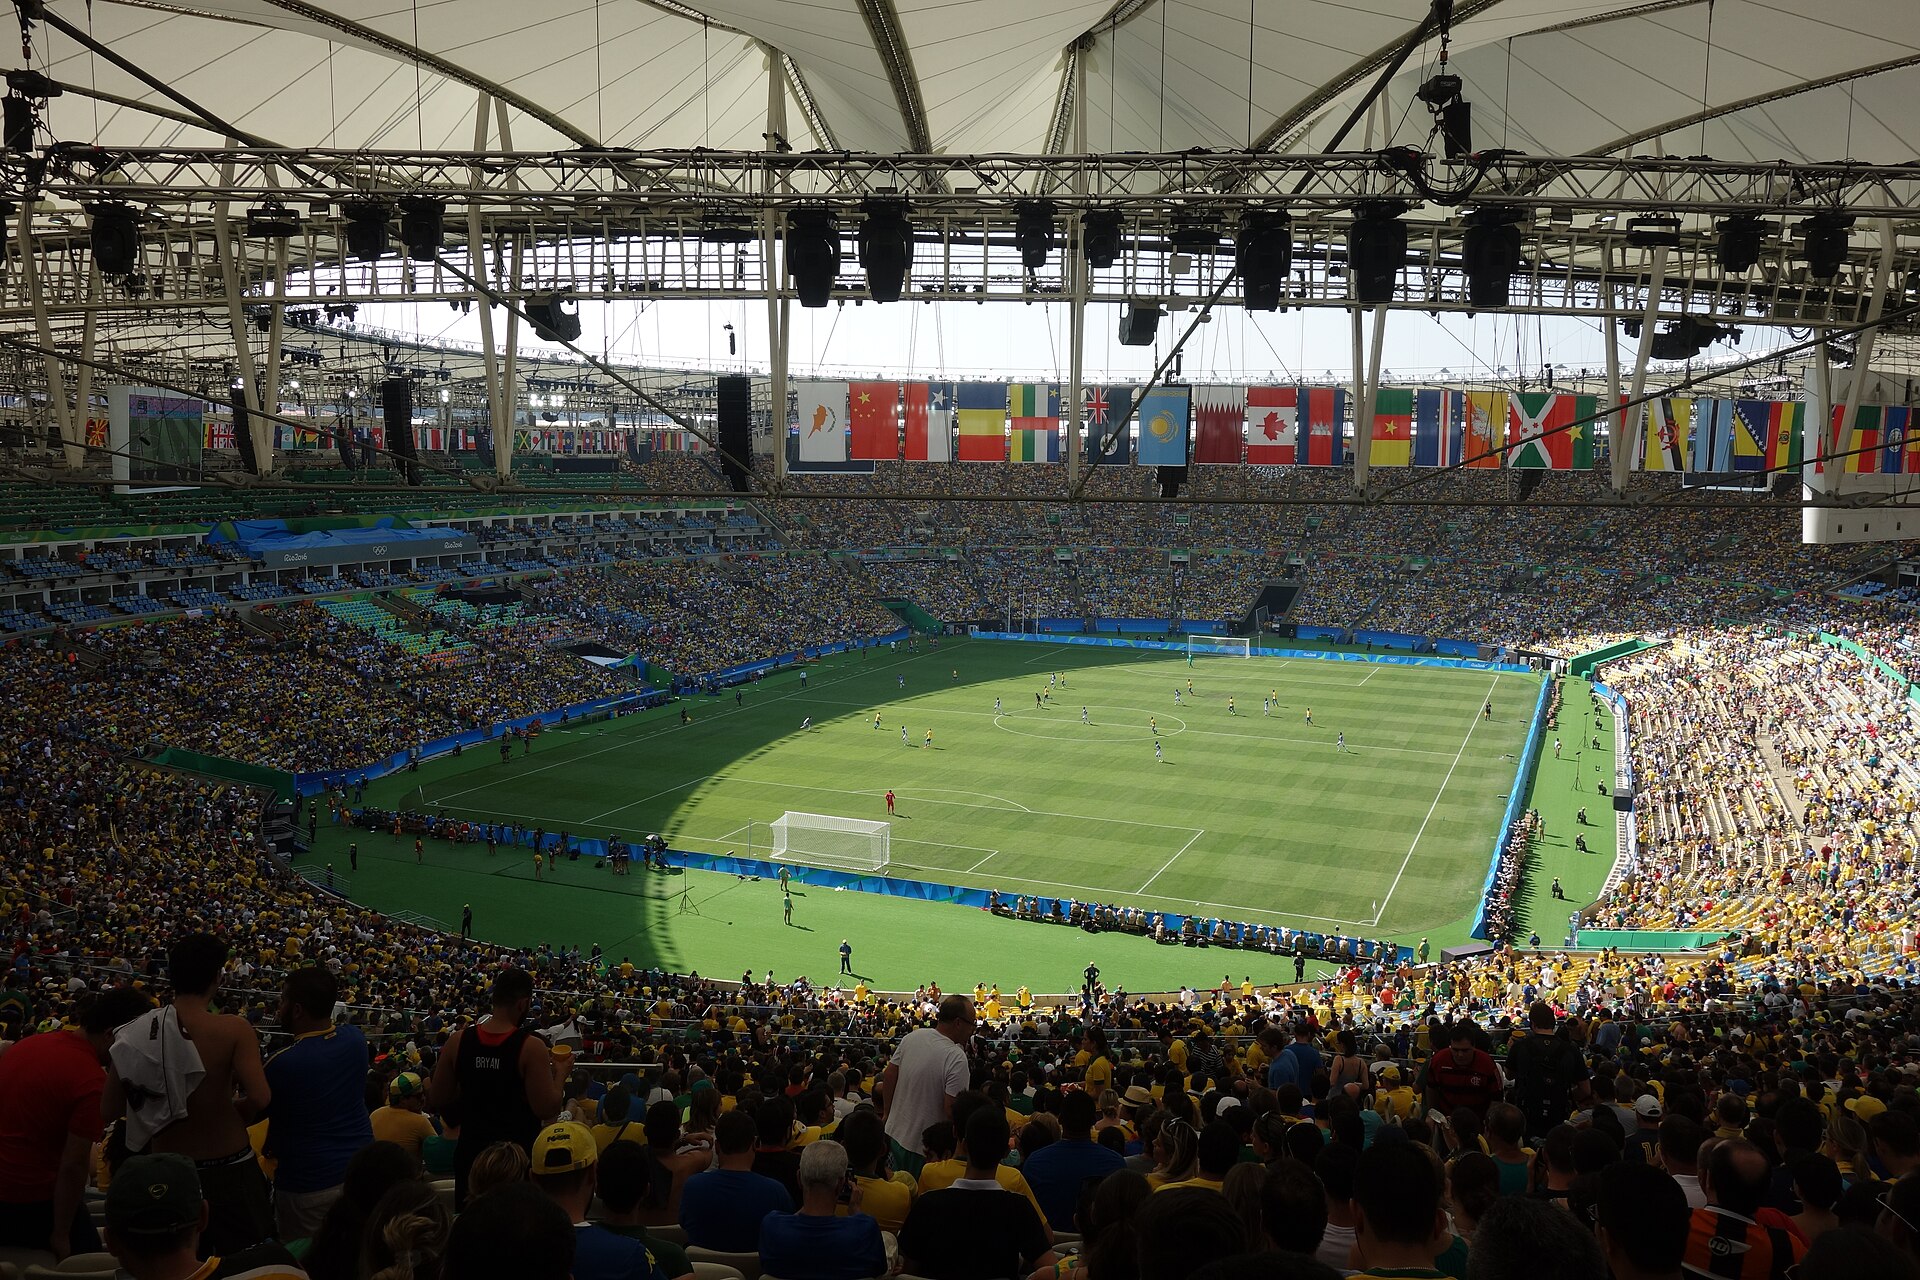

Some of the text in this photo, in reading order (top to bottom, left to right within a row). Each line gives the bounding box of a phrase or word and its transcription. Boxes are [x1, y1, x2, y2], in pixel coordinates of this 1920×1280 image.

[444, 540, 463, 549] Rio2016
[283, 552, 308, 562] Rio2016
[593, 1041, 604, 1055] 10
[475, 1056, 500, 1069] BRYAN
